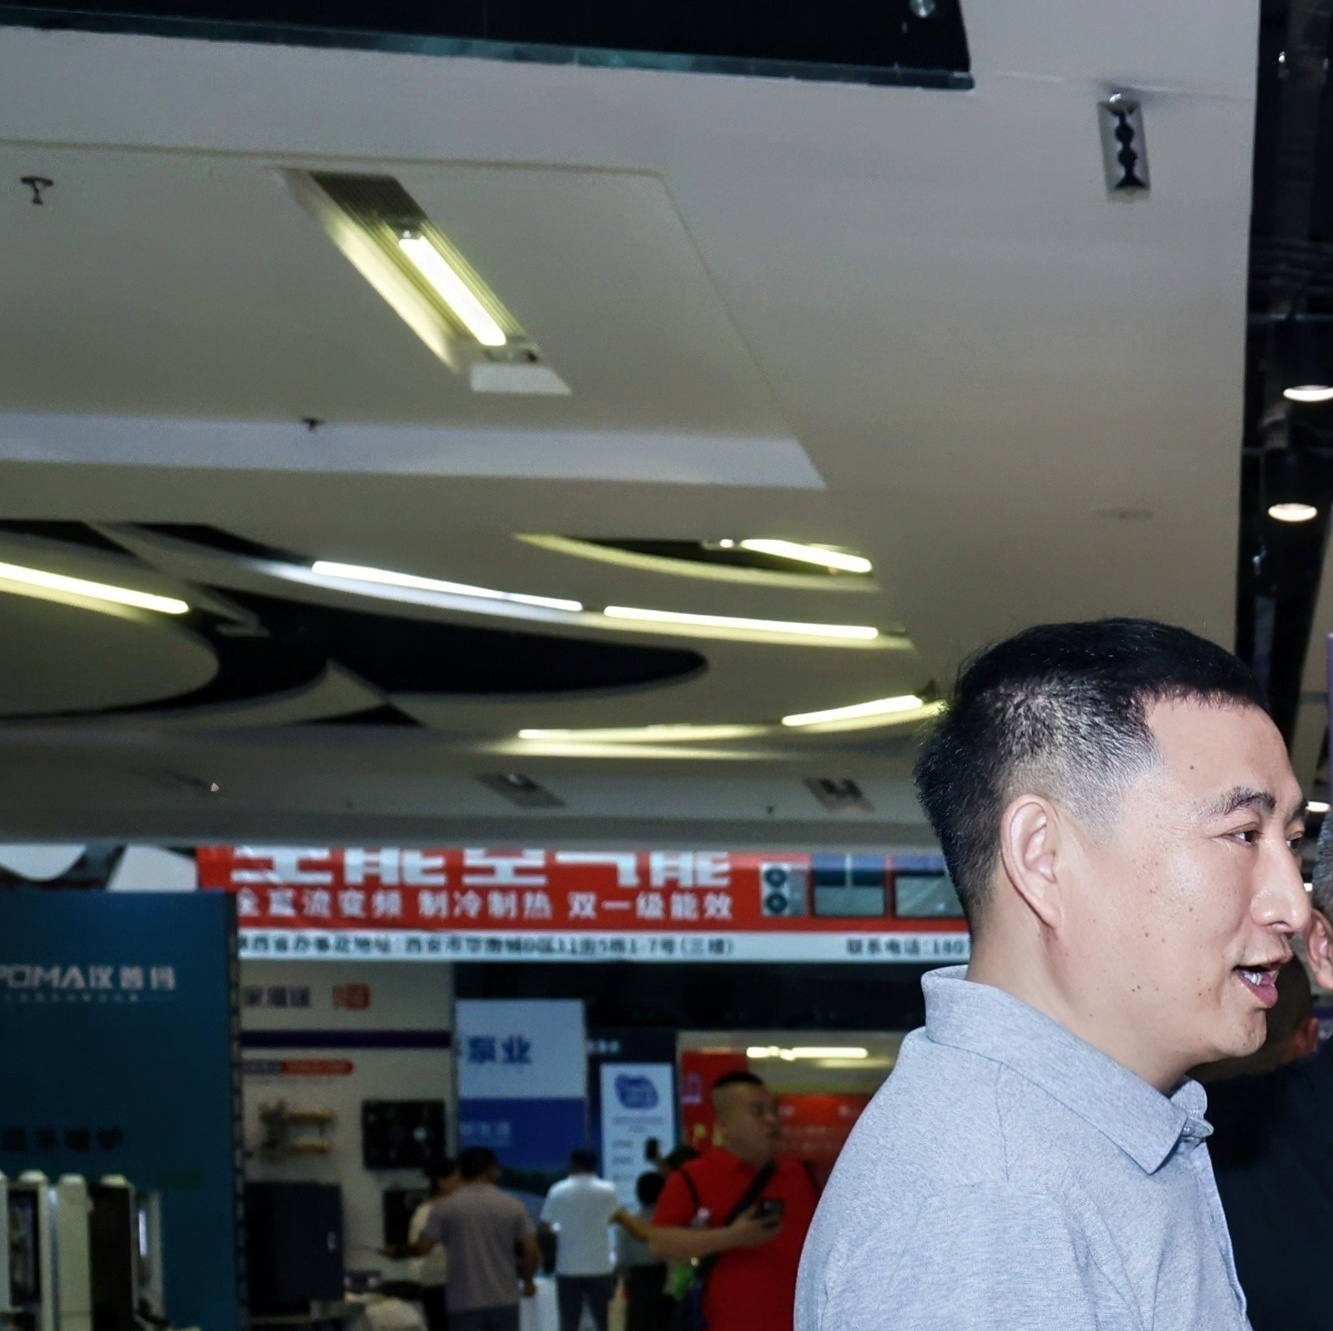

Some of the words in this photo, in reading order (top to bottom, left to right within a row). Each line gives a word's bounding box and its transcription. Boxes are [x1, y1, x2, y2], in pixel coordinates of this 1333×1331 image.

[417, 889, 552, 920] 制冷制热
[568, 891, 732, 920] 双一级能效
